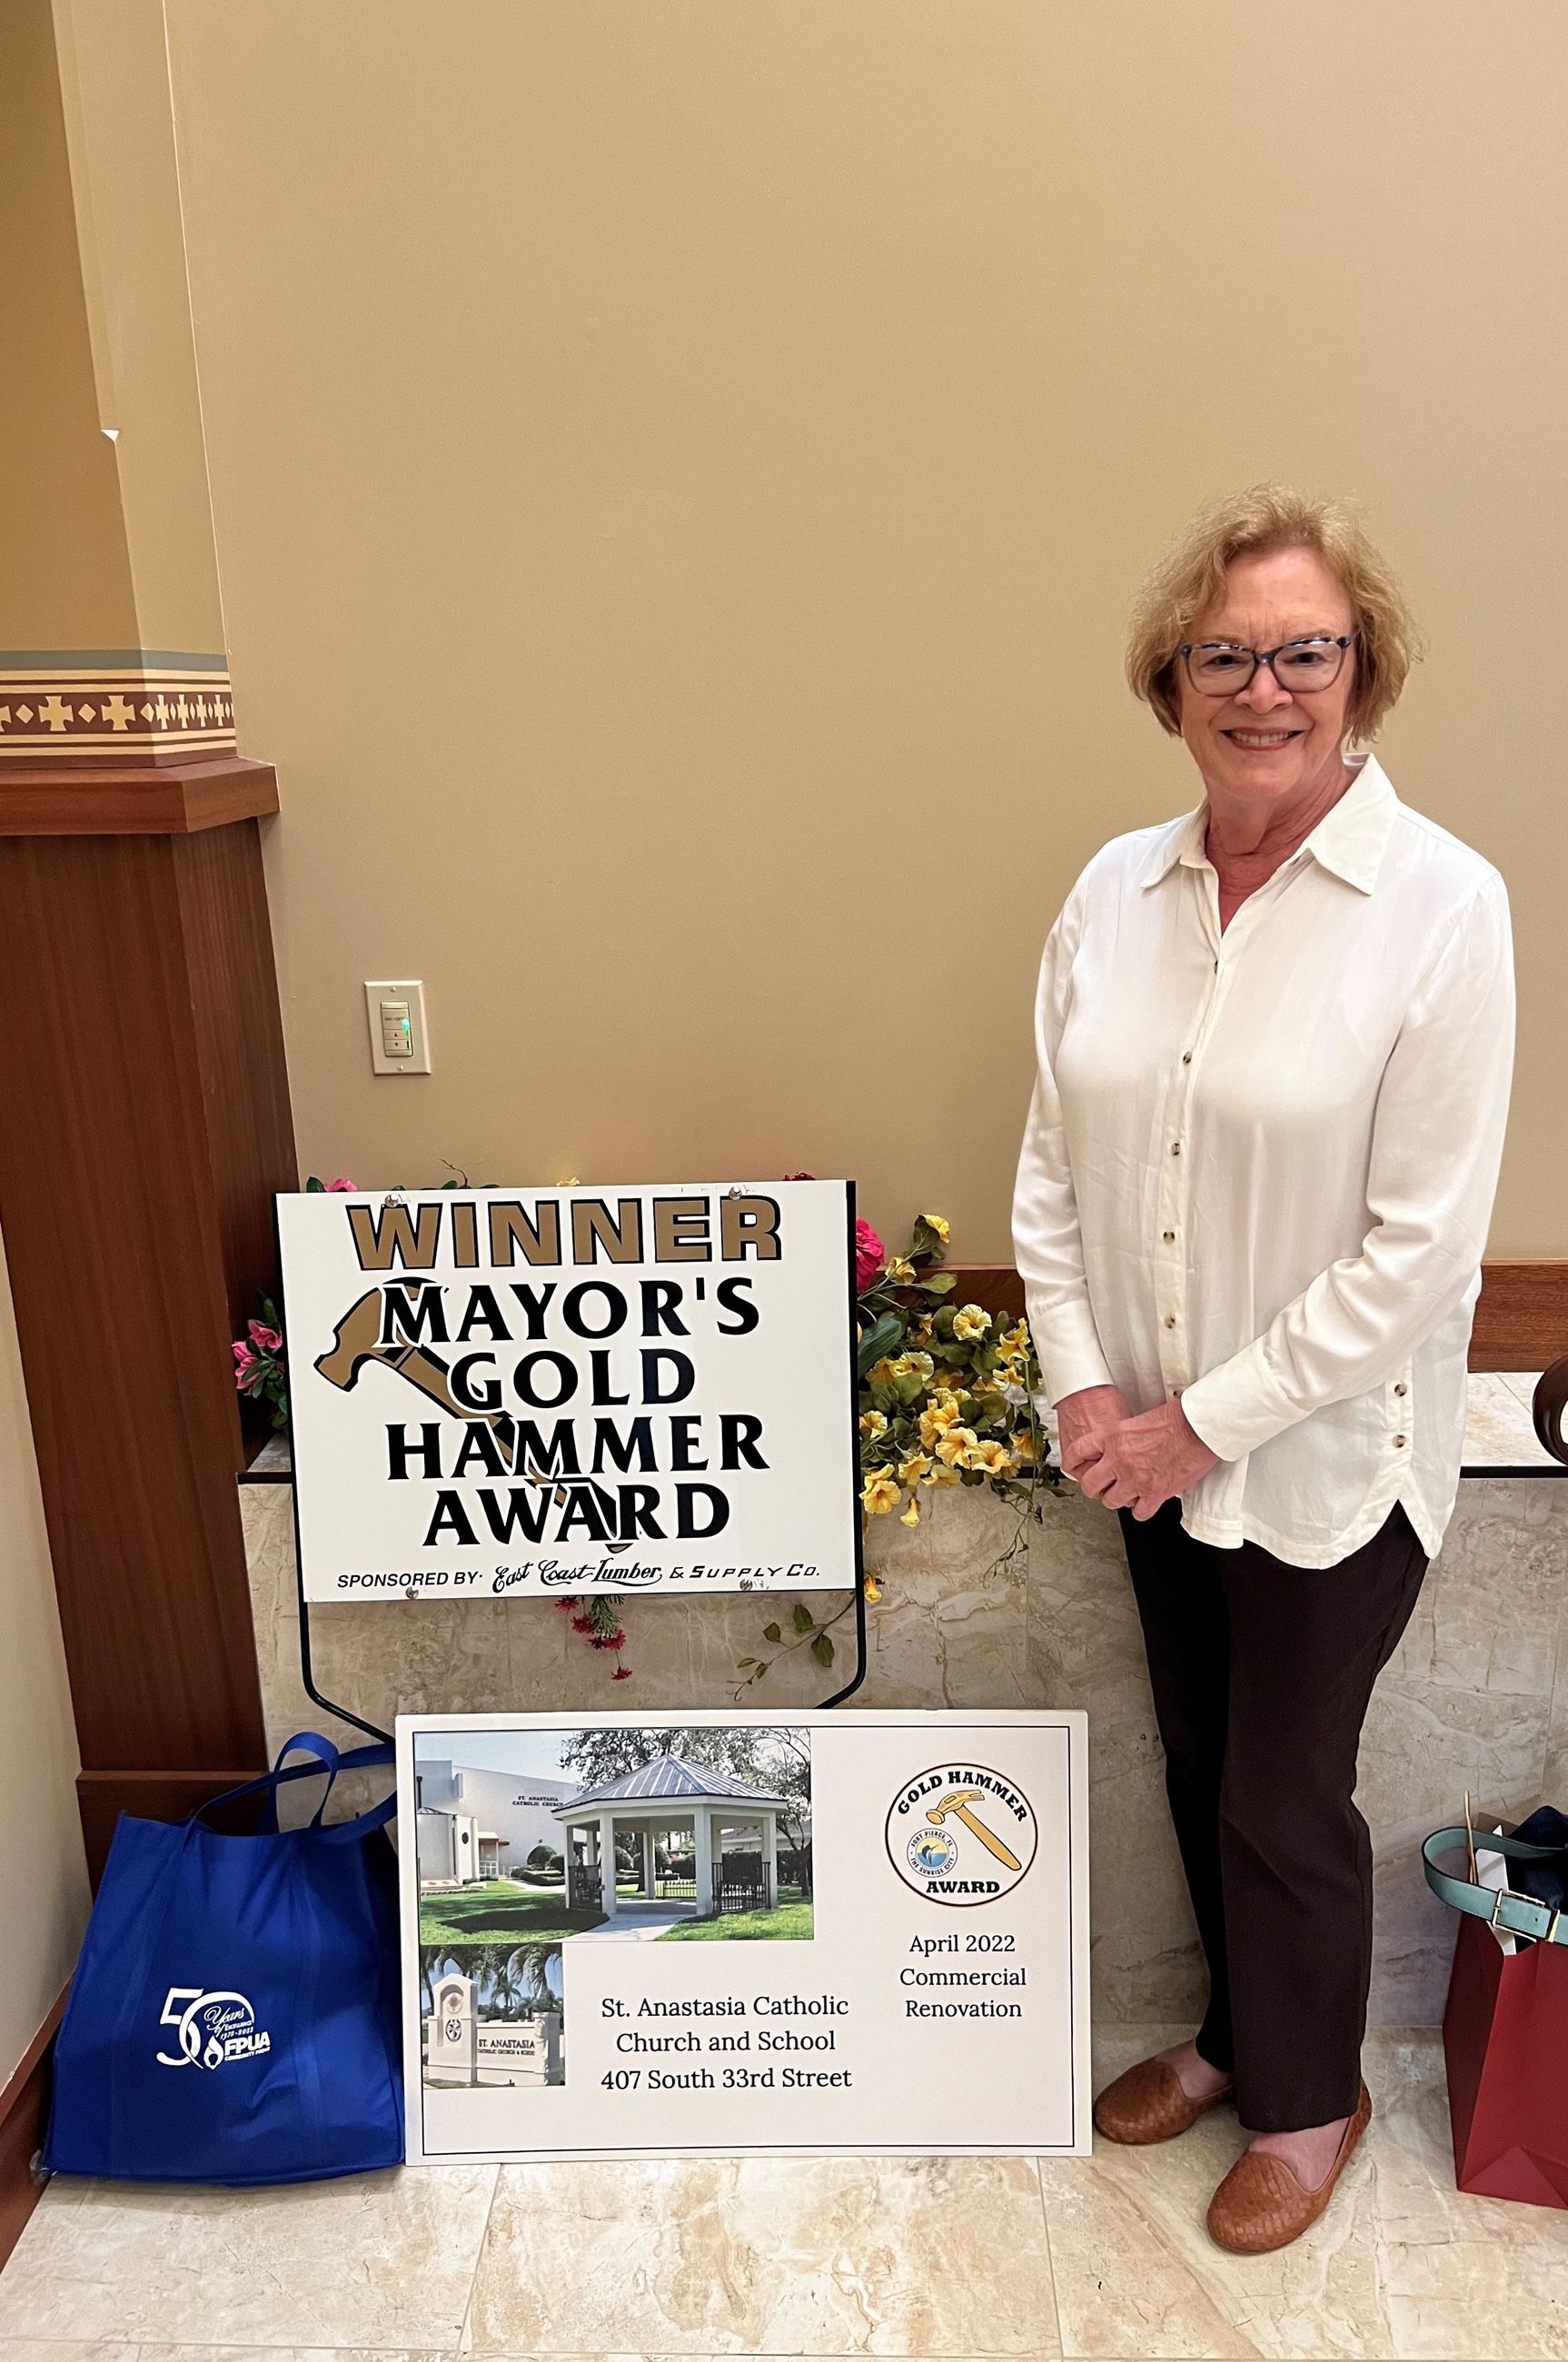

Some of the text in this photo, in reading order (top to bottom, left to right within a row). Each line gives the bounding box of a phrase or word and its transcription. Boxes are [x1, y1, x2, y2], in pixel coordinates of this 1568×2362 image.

[345, 1195, 783, 1271] WINNER
[378, 1275, 761, 1346] MAYOR'S
[450, 1348, 697, 1411] GOLD
[385, 1413, 771, 1481] HAMMER
[422, 1483, 731, 1546] AWARD
[337, 1572, 449, 1588] SPONSORED
[491, 1561, 534, 1593] East
[538, 1559, 597, 1586] Coast
[669, 1566, 684, 1579] &
[898, 1771, 1027, 1822] GOLD HAMMER
[926, 1881, 1000, 1893] AWARD
[909, 1934, 1016, 1958] April 2022
[899, 1967, 1027, 1986] Commercial
[203, 2005, 245, 2030] Years
[601, 1994, 849, 2018] St. Anastasia Catholic
[905, 2000, 1023, 2018] Renovation
[156, 1987, 255, 2069] 50
[223, 2030, 272, 2057] FPUA
[491, 2039, 535, 2049] ANASTASIA
[616, 2030, 836, 2053] Church and School
[600, 2067, 853, 2090] 407 South 33rd Street
